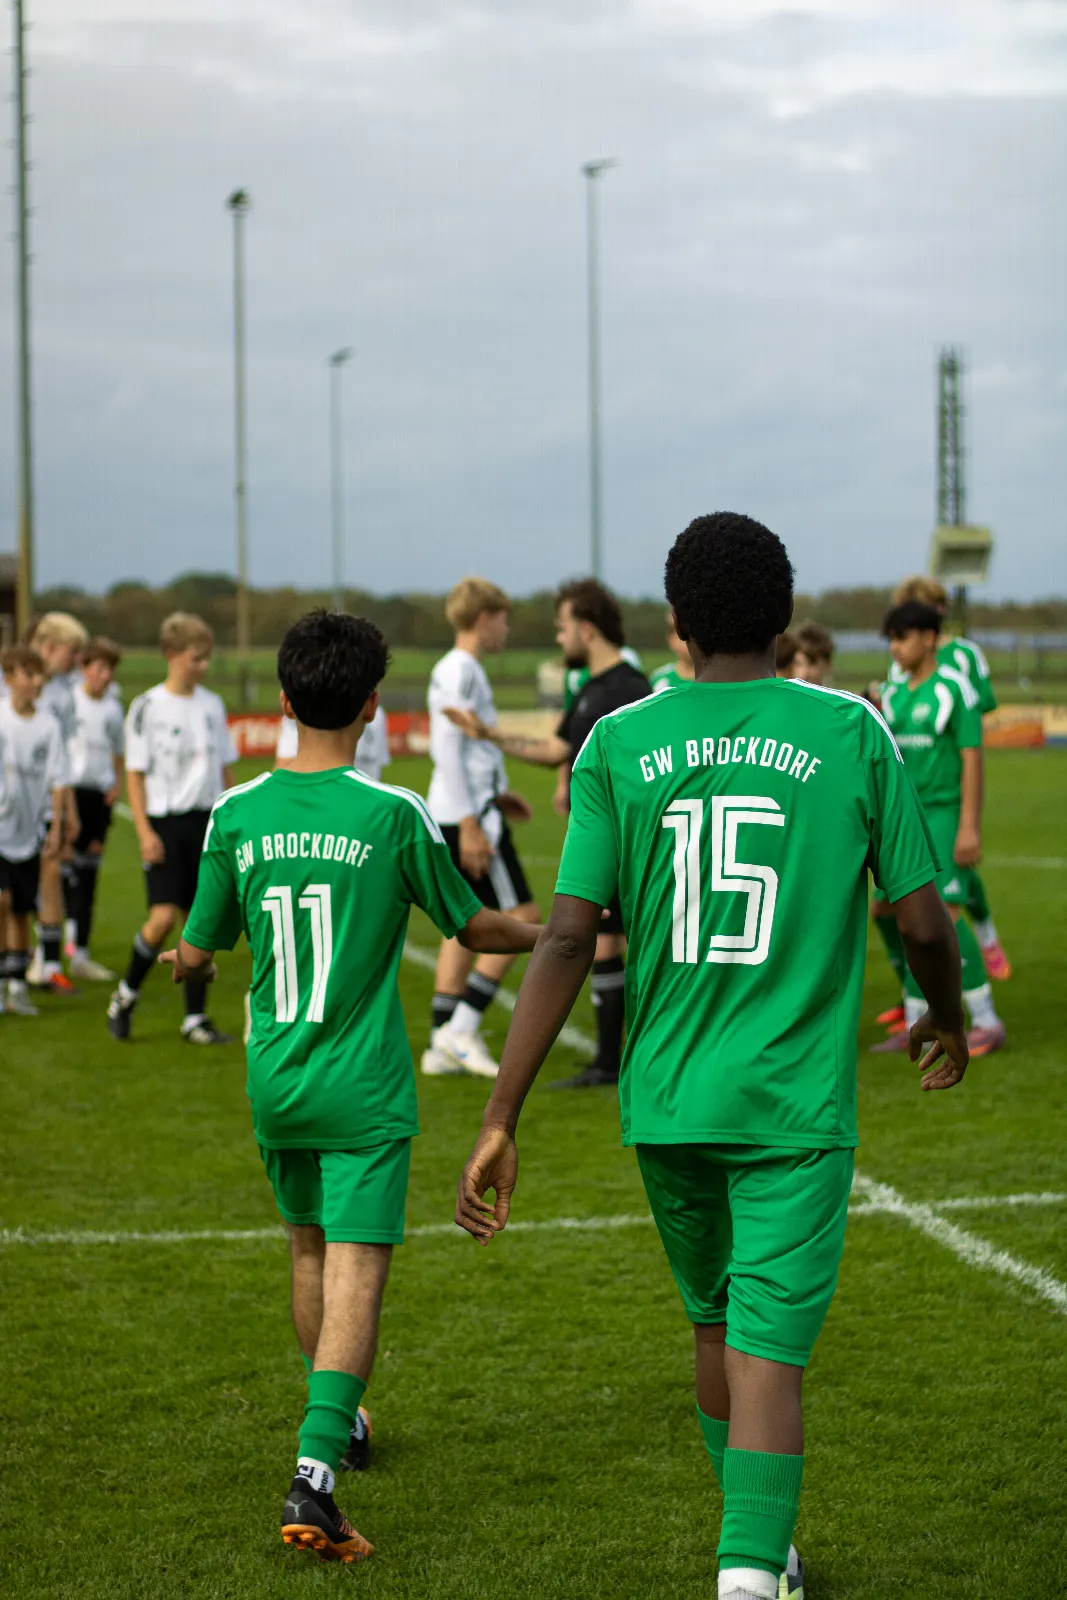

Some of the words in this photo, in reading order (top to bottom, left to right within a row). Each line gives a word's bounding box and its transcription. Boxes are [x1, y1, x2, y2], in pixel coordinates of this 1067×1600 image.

[639, 745, 673, 782] GW
[685, 736, 822, 783] BROCKDORF
[235, 840, 254, 873] GW
[262, 832, 373, 868] BROCKDORF
[661, 795, 785, 965] 15
[261, 884, 333, 1023] 11
